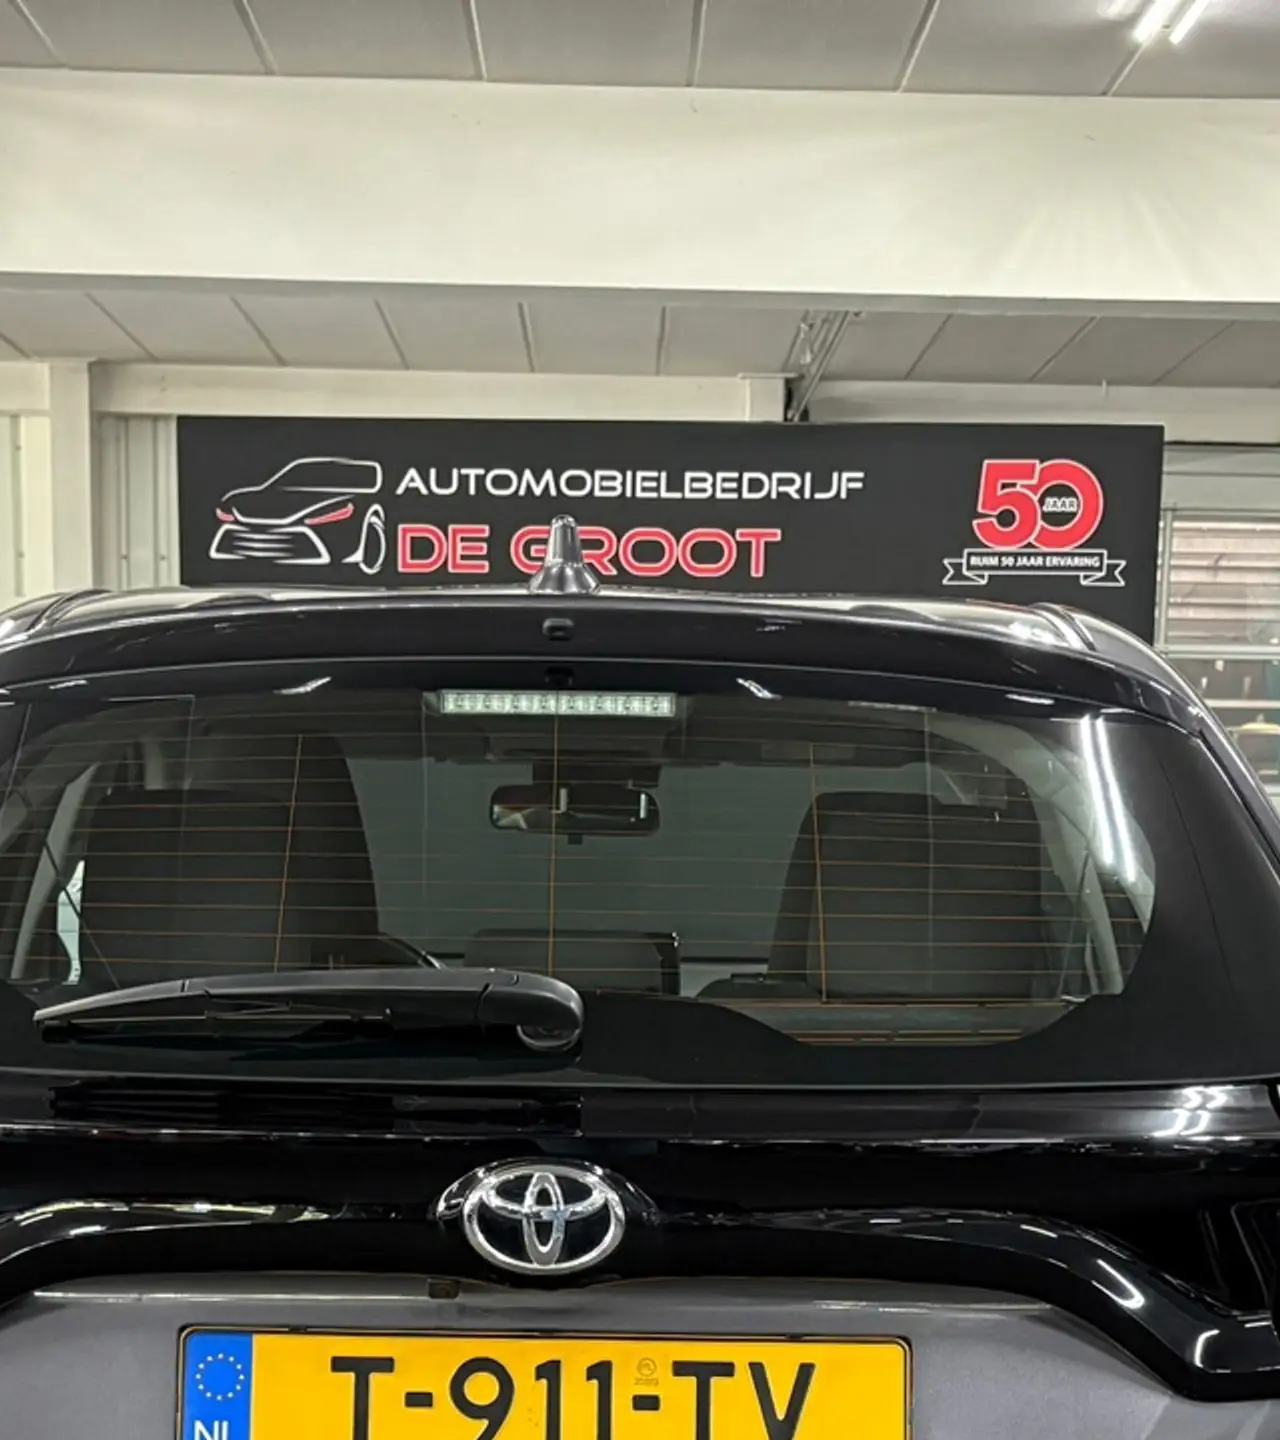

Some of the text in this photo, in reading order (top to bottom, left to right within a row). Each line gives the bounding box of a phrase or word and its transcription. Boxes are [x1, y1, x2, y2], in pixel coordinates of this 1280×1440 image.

[395, 467, 866, 500] AUTOMOBIELBEDRIJF
[972, 458, 1104, 551] 50
[1042, 496, 1080, 513] JAAR
[397, 523, 782, 578] DE GROOT
[969, 555, 1100, 568] RUIM 50 JAAR ERVARING
